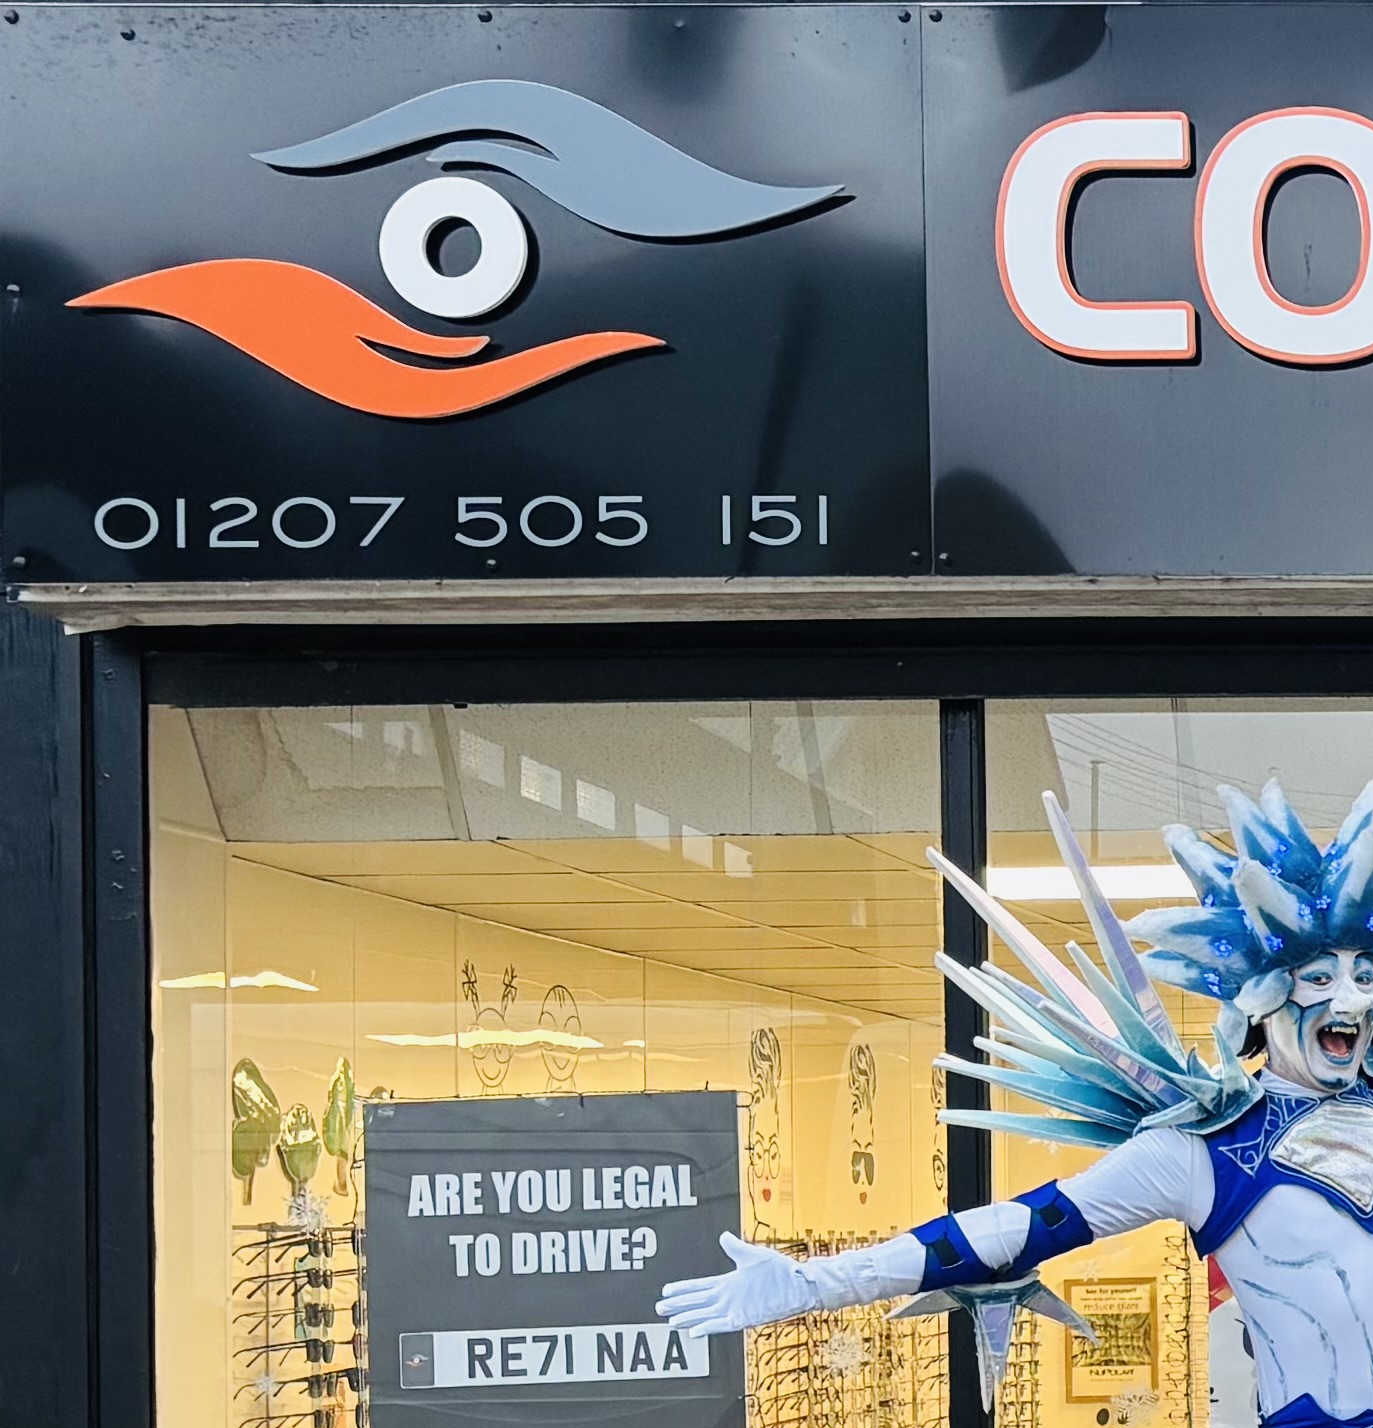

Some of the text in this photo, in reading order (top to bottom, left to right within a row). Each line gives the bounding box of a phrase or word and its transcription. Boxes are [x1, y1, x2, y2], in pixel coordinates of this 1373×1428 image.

[94, 494, 828, 549] 01207 505 151
[408, 1164, 698, 1217] ARE YOU LEGAL
[449, 1227, 657, 1277] TO DRIVE?
[598, 1329, 688, 1374] NAA
